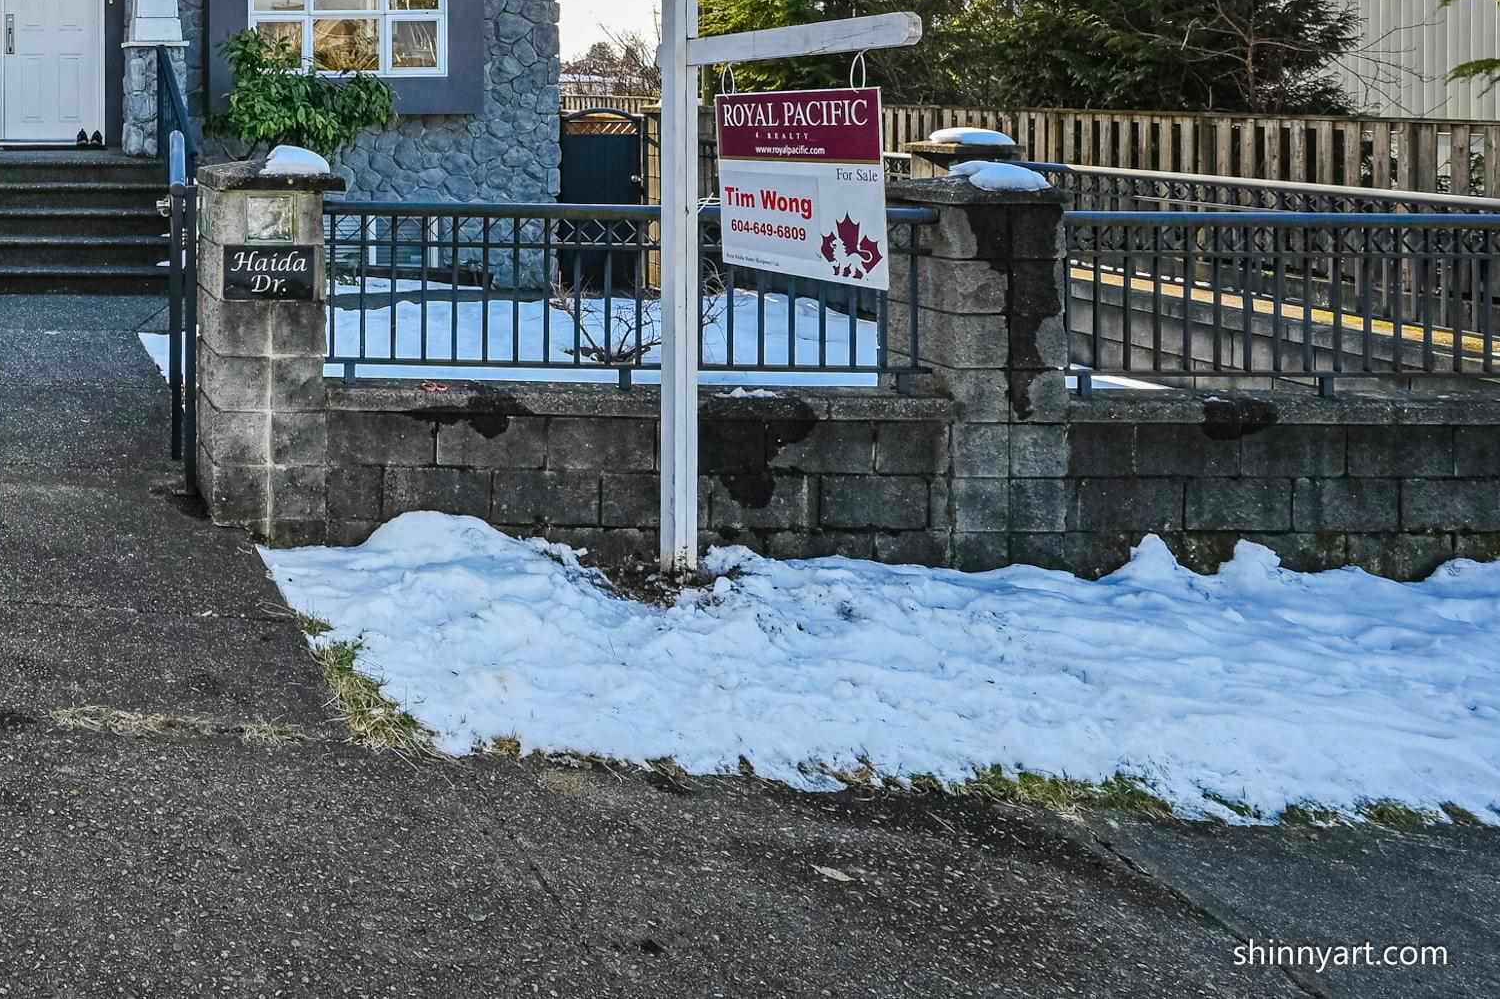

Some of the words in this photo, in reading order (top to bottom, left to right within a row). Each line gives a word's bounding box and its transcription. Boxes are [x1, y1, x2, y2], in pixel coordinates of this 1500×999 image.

[723, 103, 779, 128] ROYAL
[783, 99, 868, 127] PACIFIC
[767, 132, 809, 140] REALTY
[755, 145, 826, 156] www.royalpacific.com
[836, 168, 852, 182] For
[856, 168, 878, 182] Sale
[724, 186, 756, 208] Tim
[760, 189, 813, 220] Wong
[731, 219, 806, 241] 604-649-6809
[230, 250, 308, 272] Haida
[251, 274, 287, 293] Dr.
